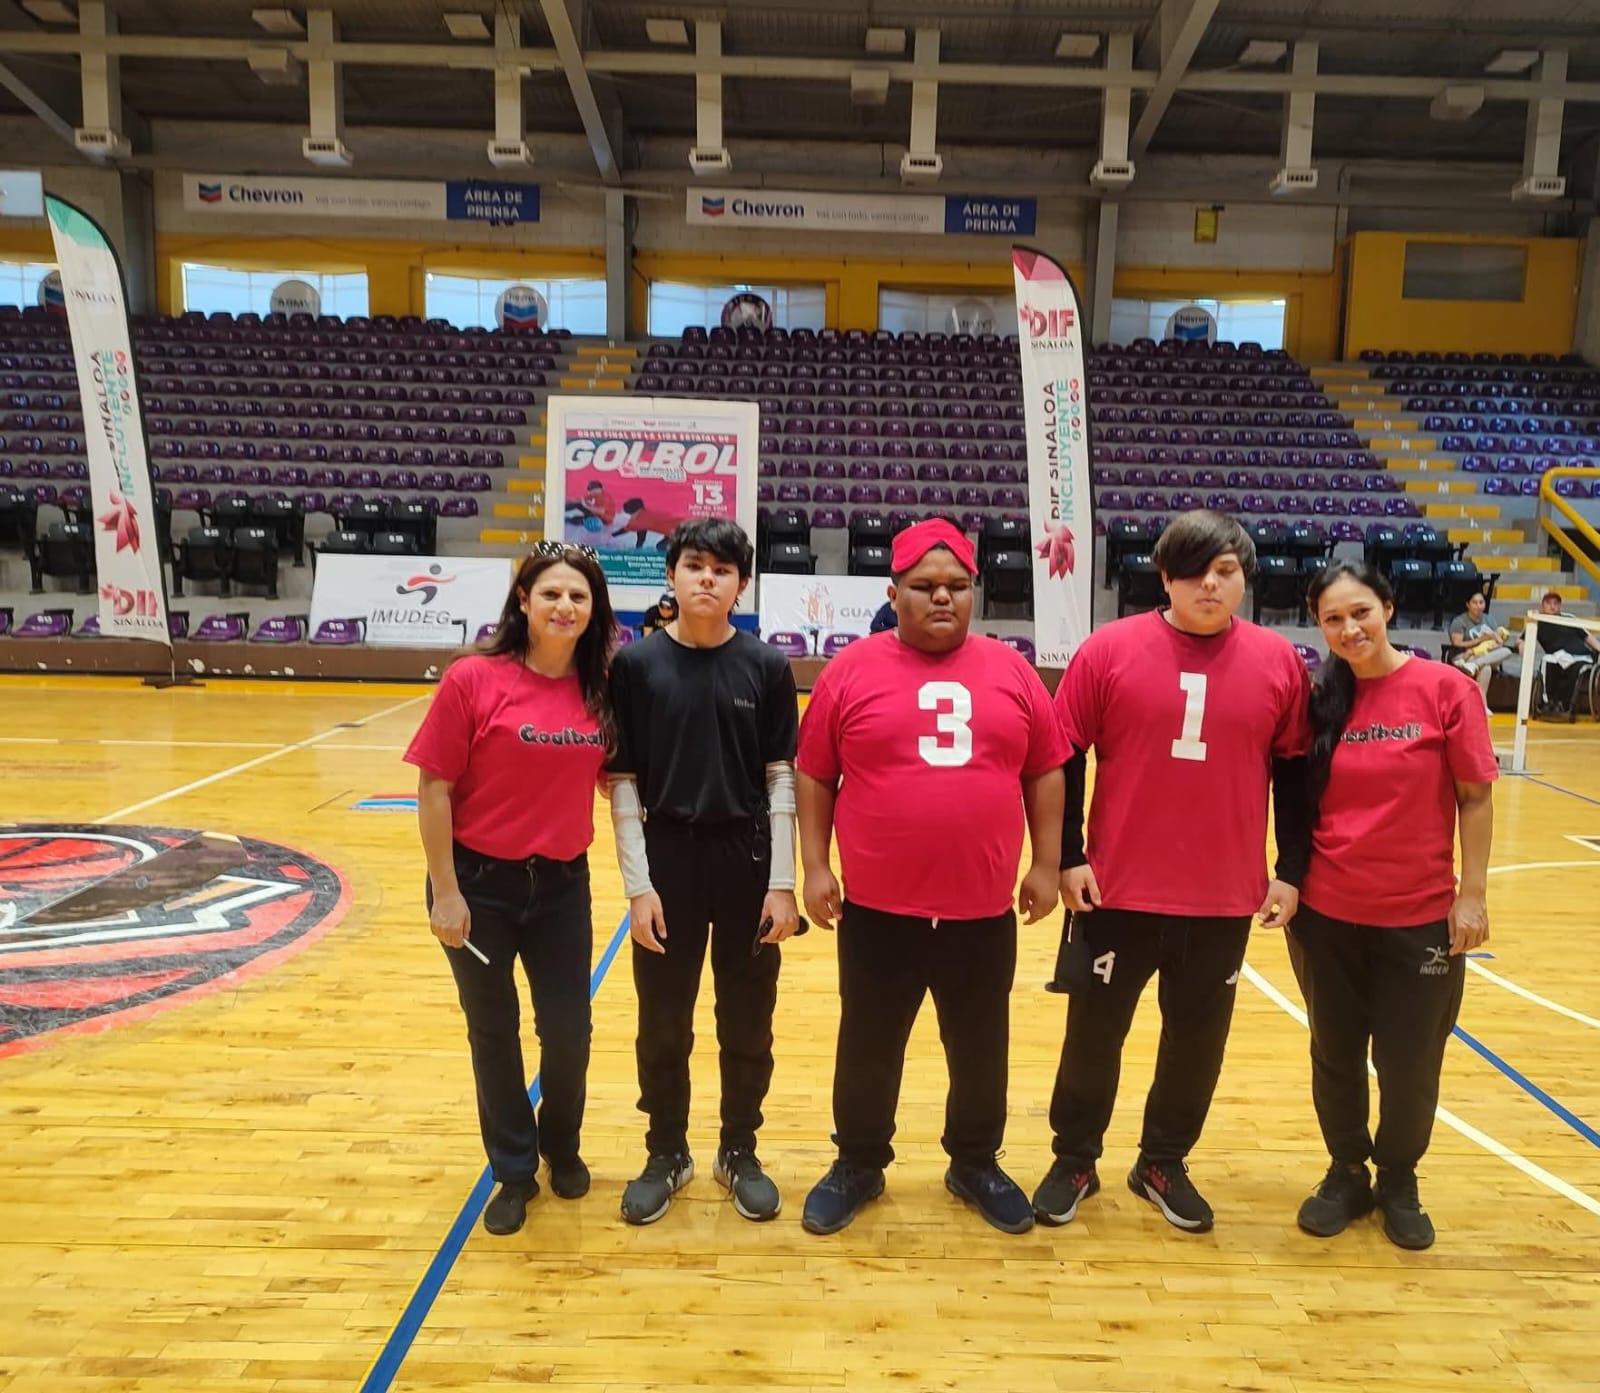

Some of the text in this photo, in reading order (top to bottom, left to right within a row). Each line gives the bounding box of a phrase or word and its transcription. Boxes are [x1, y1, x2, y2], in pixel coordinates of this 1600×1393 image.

[229, 184, 304, 203] Chevron
[464, 187, 523, 203] ÁREA DE
[466, 204, 520, 219] PRENSA
[732, 199, 804, 218] Chevron
[962, 202, 1020, 217] ÁREA DE
[965, 218, 1017, 232] PRENSA
[1029, 310, 1074, 337] DIF
[1031, 340, 1074, 349] SINALOA
[1043, 381, 1059, 480] SINALOA
[566, 439, 737, 475] GOLBOL
[1056, 378, 1073, 521] INCLUYENTE
[692, 484, 724, 505] 13
[371, 608, 450, 624] IMUDEG
[840, 607, 877, 618] GUA
[918, 681, 973, 766] 3
[1171, 671, 1207, 761] 1
[1340, 722, 1422, 744] oalball
